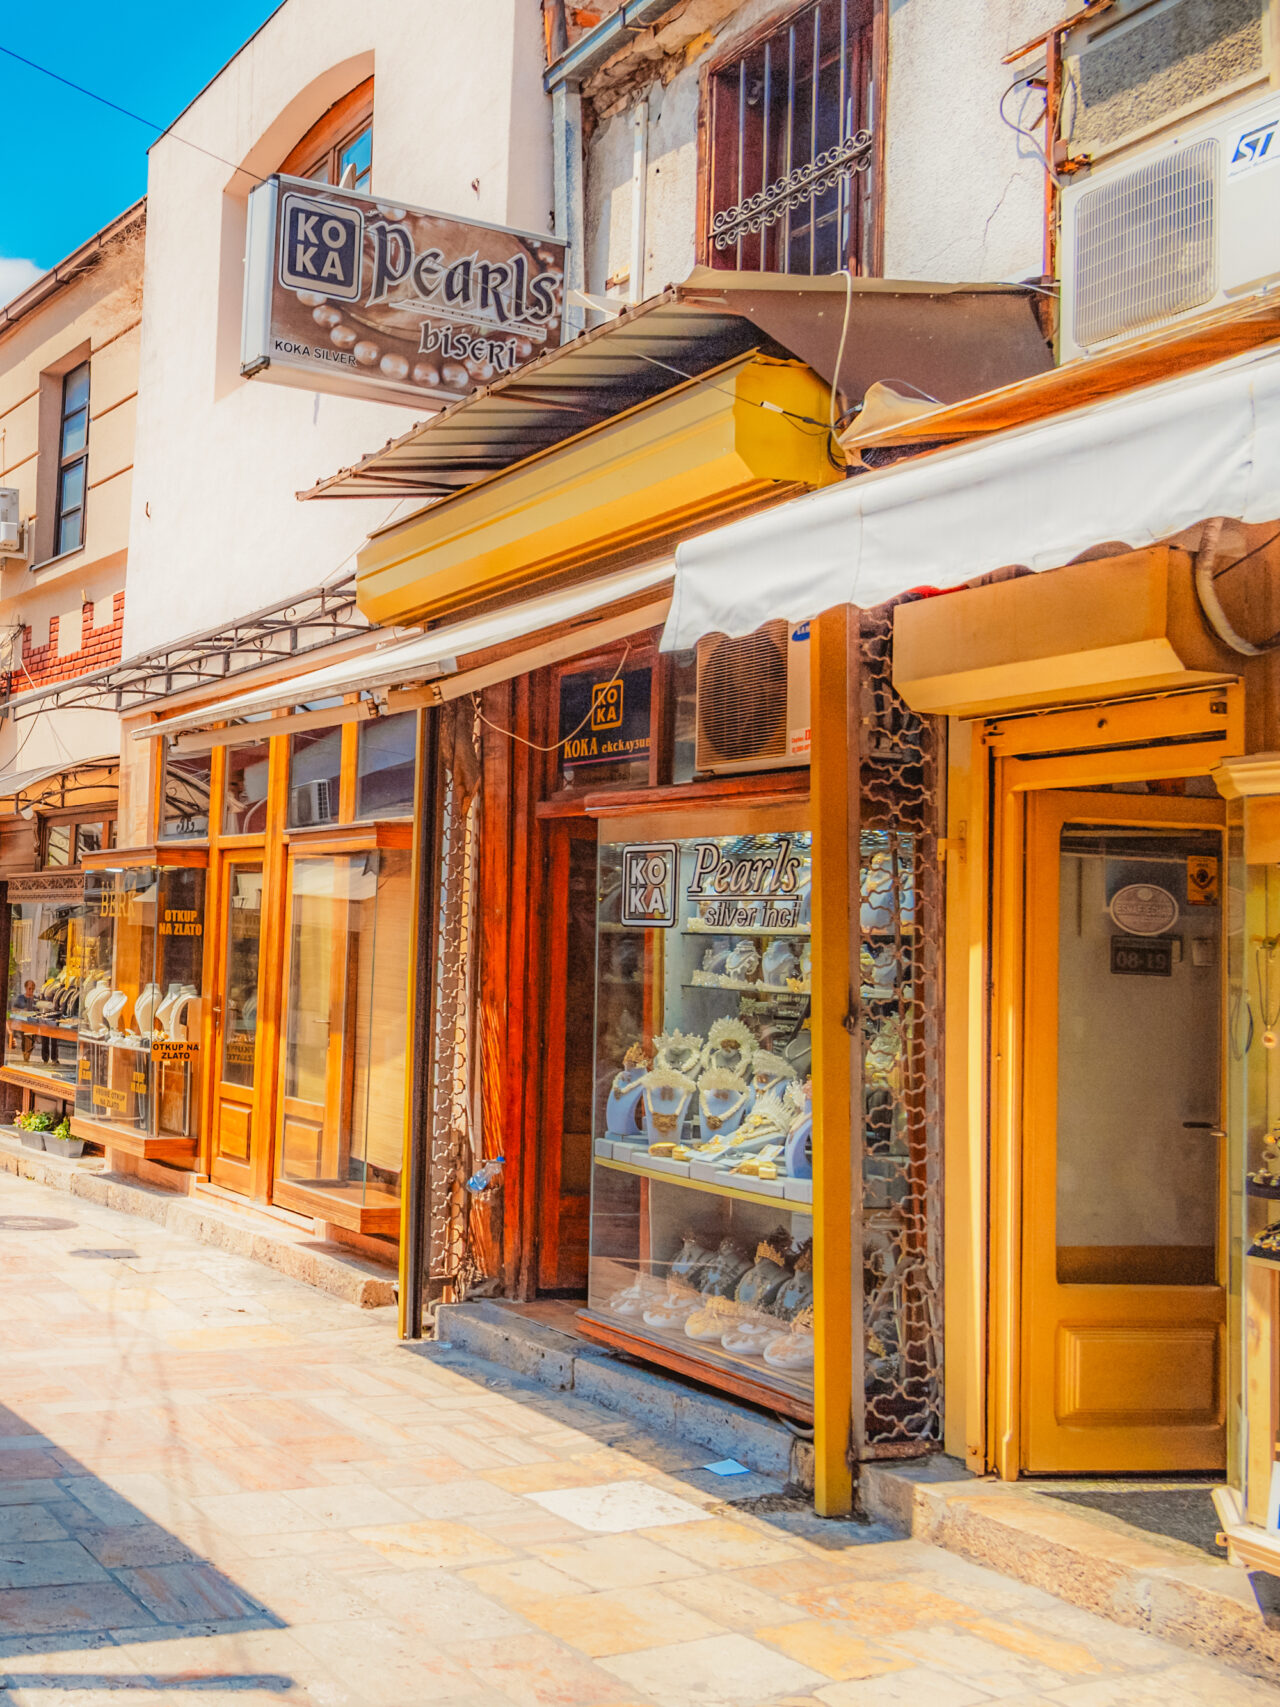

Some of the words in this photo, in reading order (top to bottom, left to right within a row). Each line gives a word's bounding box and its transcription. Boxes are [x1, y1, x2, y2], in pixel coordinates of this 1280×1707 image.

[296, 213, 347, 249] KO
[295, 243, 345, 282] KA
[275, 340, 310, 356] KOKA
[314, 347, 357, 365] SILVER
[418, 320, 523, 373] biseri
[597, 688, 618, 706] KO
[596, 706, 617, 723] KA
[630, 856, 667, 885] KO
[687, 838, 803, 894] Pearls
[629, 886, 666, 914] KA
[164, 910, 198, 922] OTKUP
[704, 901, 757, 927] silver
[762, 902, 801, 928] inci
[159, 923, 172, 935] NA
[173, 923, 203, 936] ZLATO
[153, 1043, 184, 1051] OTKUP
[186, 1043, 199, 1051] NA
[161, 1052, 191, 1060] ZLATO
